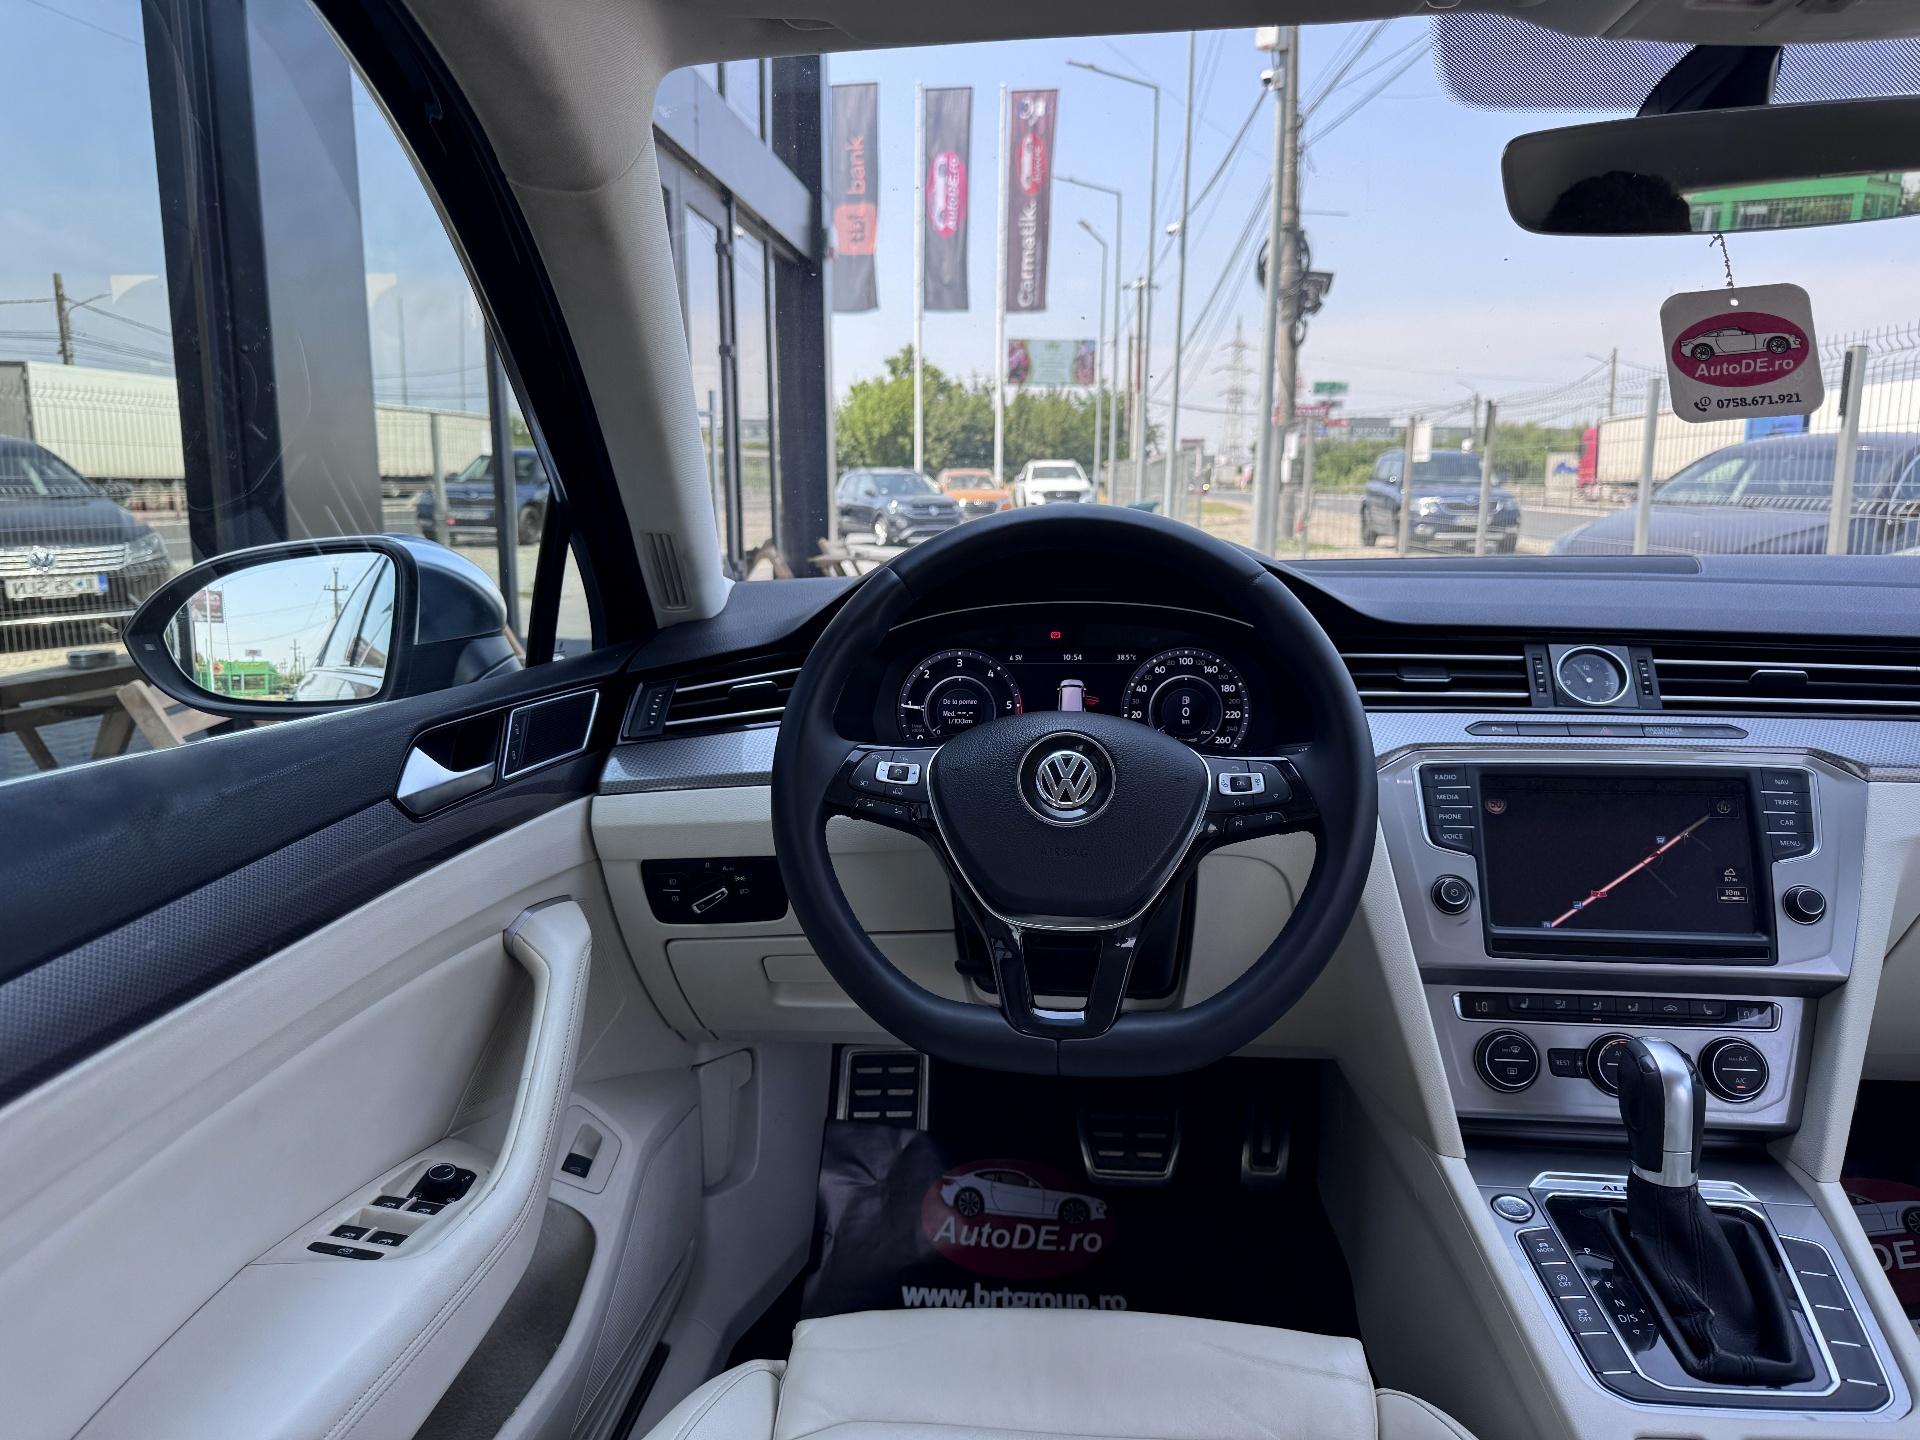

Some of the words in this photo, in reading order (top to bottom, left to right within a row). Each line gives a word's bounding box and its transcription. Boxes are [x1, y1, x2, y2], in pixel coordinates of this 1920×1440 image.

[846, 135, 866, 195] bank
[1017, 203, 1038, 308] Carmatik
[1695, 357, 1794, 378] AutoDE.ro
[1716, 392, 1802, 409] 0758.671.921
[1063, 653, 1083, 661] 10:54
[1178, 657, 1194, 666] 100
[956, 658, 963, 668] 3
[923, 669, 930, 679] 2
[987, 669, 994, 678] 4
[1154, 665, 1166, 674] 60
[1203, 665, 1219, 674] 140
[1135, 685, 1148, 693] 40
[1220, 685, 1236, 693] 180
[1006, 701, 1013, 710] 5
[1131, 710, 1142, 719] 20
[1181, 707, 1190, 717] 0
[1225, 710, 1241, 719] 220
[1214, 736, 1231, 744] 260
[933, 1216, 1103, 1253] AutoDE.ro
[1583, 1247, 1591, 1255] P
[1604, 1281, 1614, 1289] R
[1614, 1299, 1626, 1308] N
[1617, 1313, 1639, 1323] D/S
